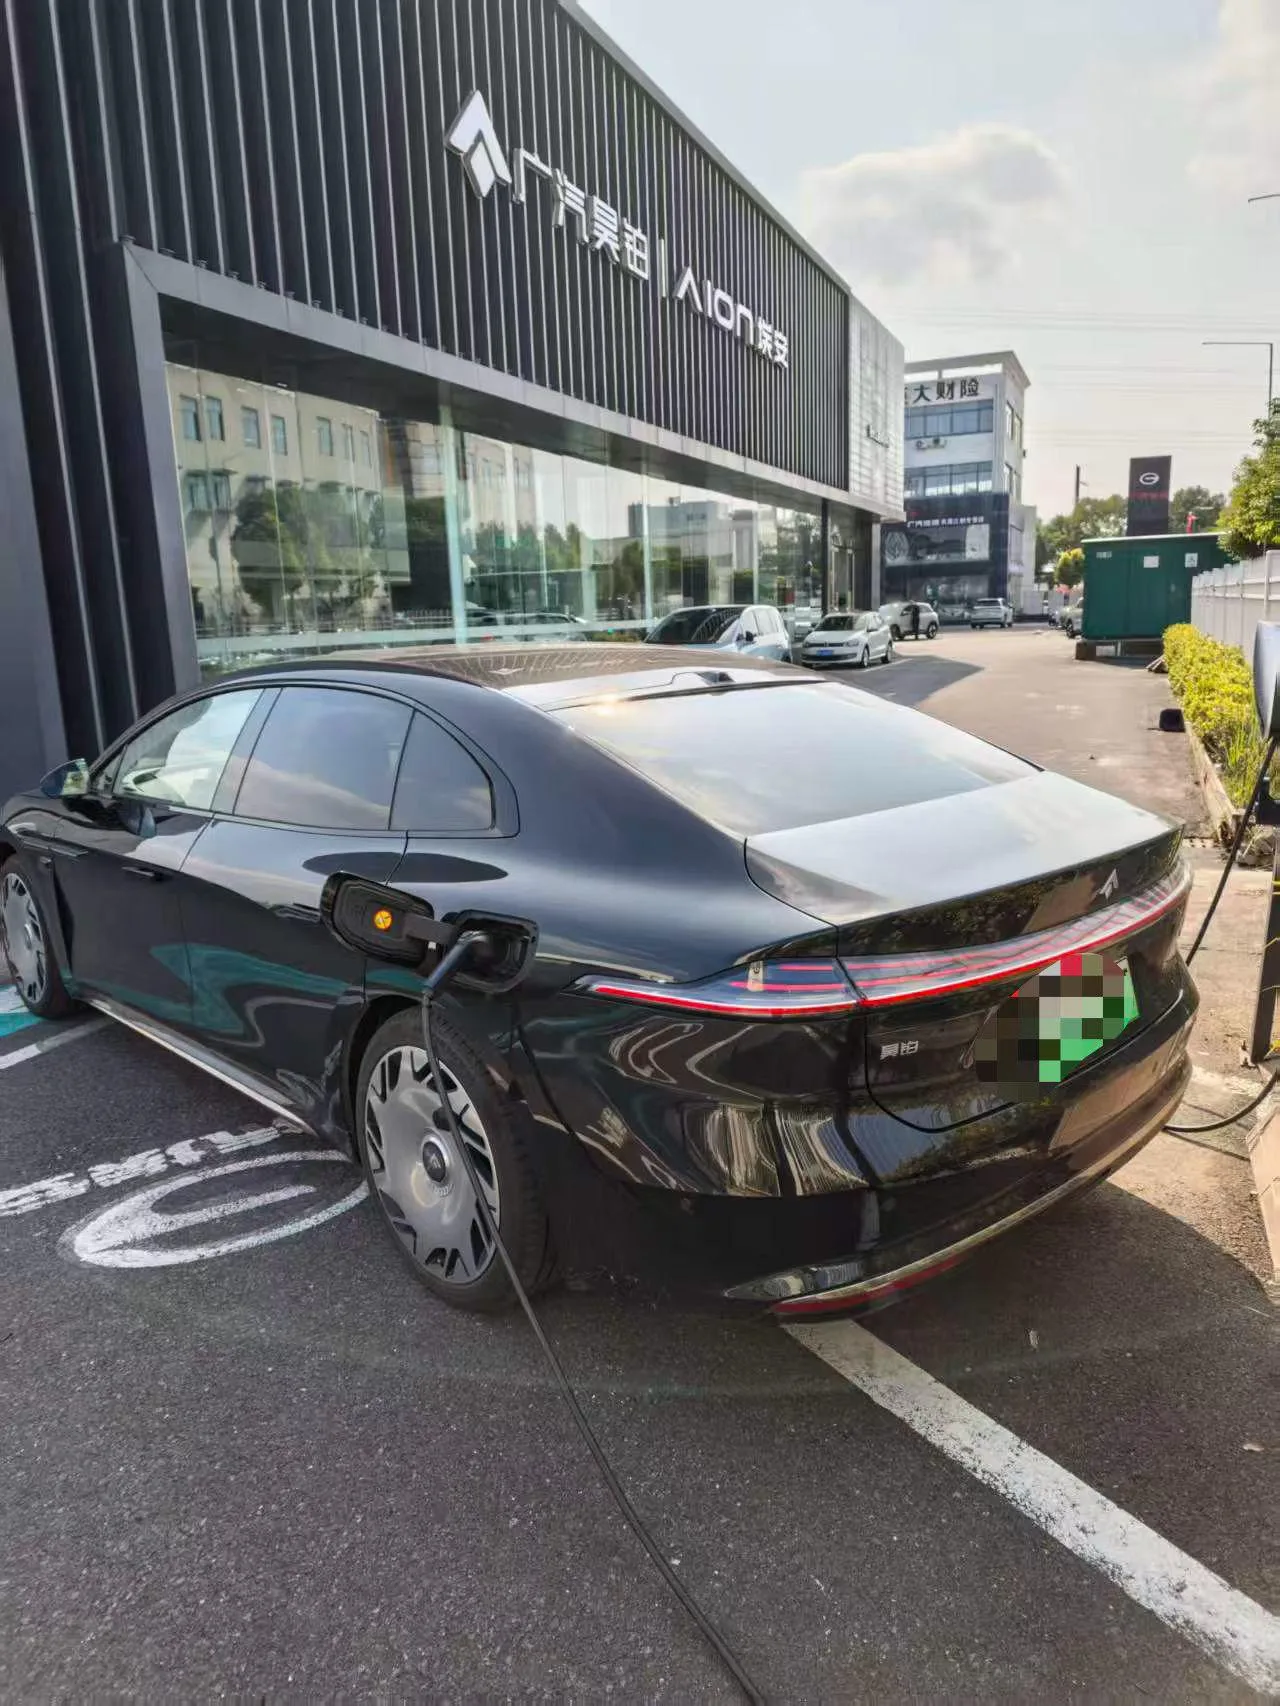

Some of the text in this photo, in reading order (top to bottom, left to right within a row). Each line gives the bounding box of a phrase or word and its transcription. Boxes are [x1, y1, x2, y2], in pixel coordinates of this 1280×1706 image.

[513, 148, 649, 281] 广汽昊铂
[904, 377, 979, 405] 大财险
